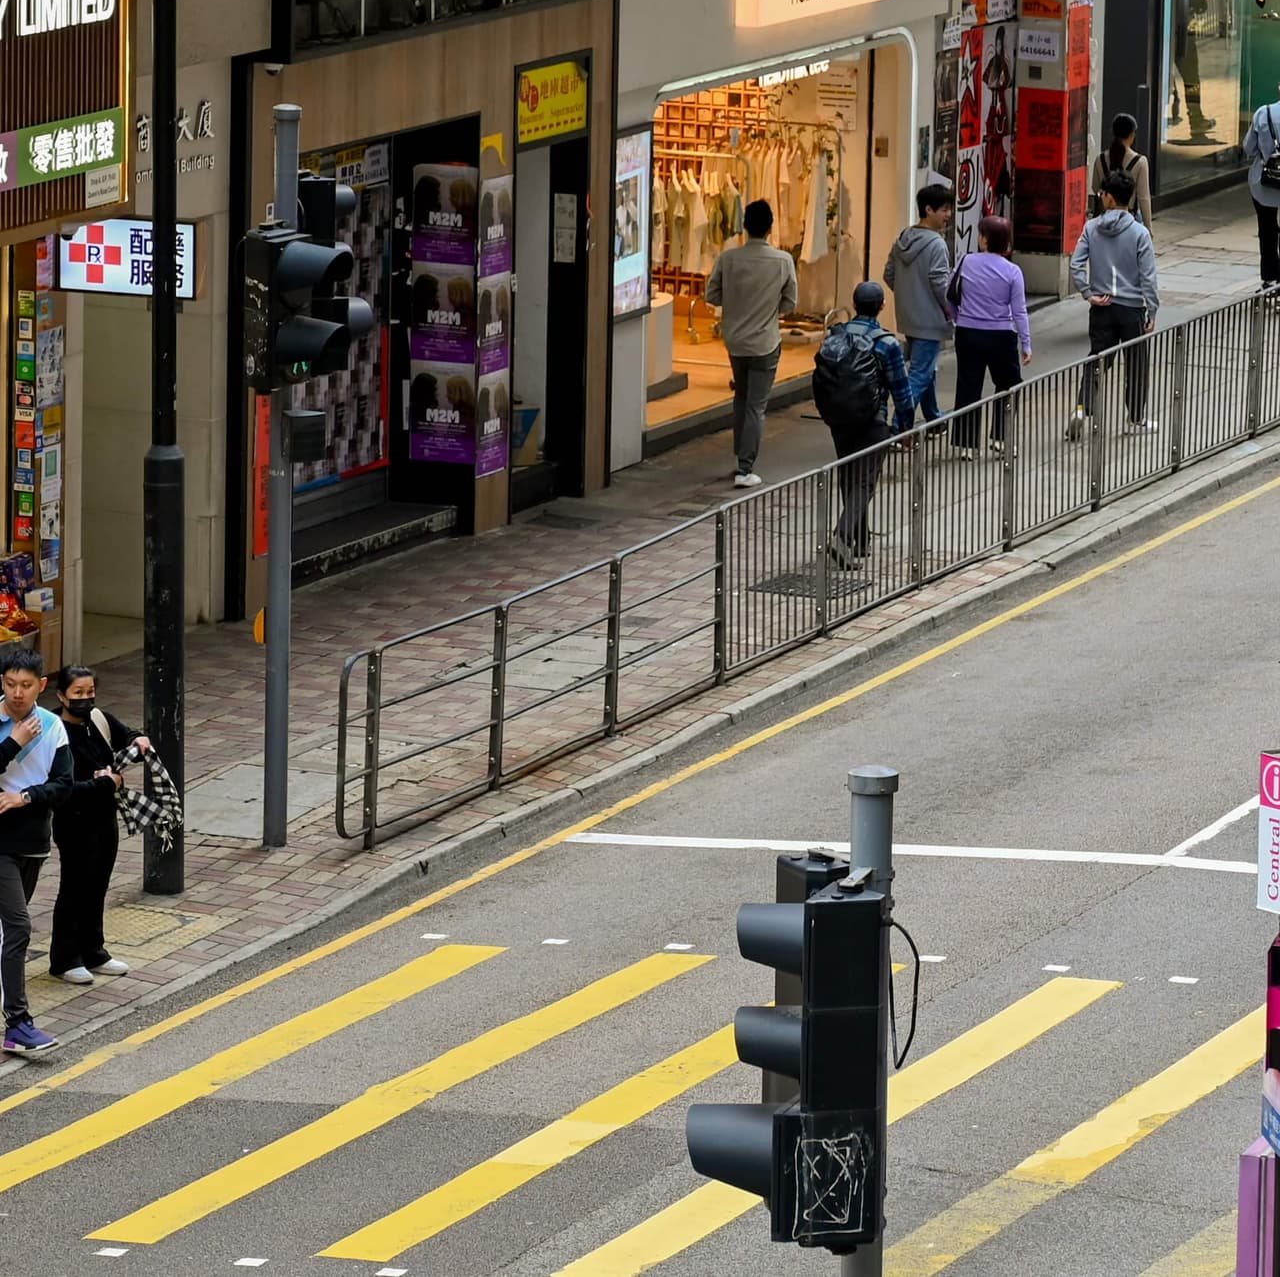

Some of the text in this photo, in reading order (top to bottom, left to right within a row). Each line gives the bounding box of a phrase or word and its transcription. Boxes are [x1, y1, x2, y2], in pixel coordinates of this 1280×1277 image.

[137, 100, 215, 153] 商大廈
[29, 121, 115, 175] 零售批發
[181, 155, 215, 172] Building
[429, 210, 462, 227] M2M
[427, 309, 461, 325] M2M
[426, 407, 460, 424] M2M
[1267, 818, 1280, 900] Central
